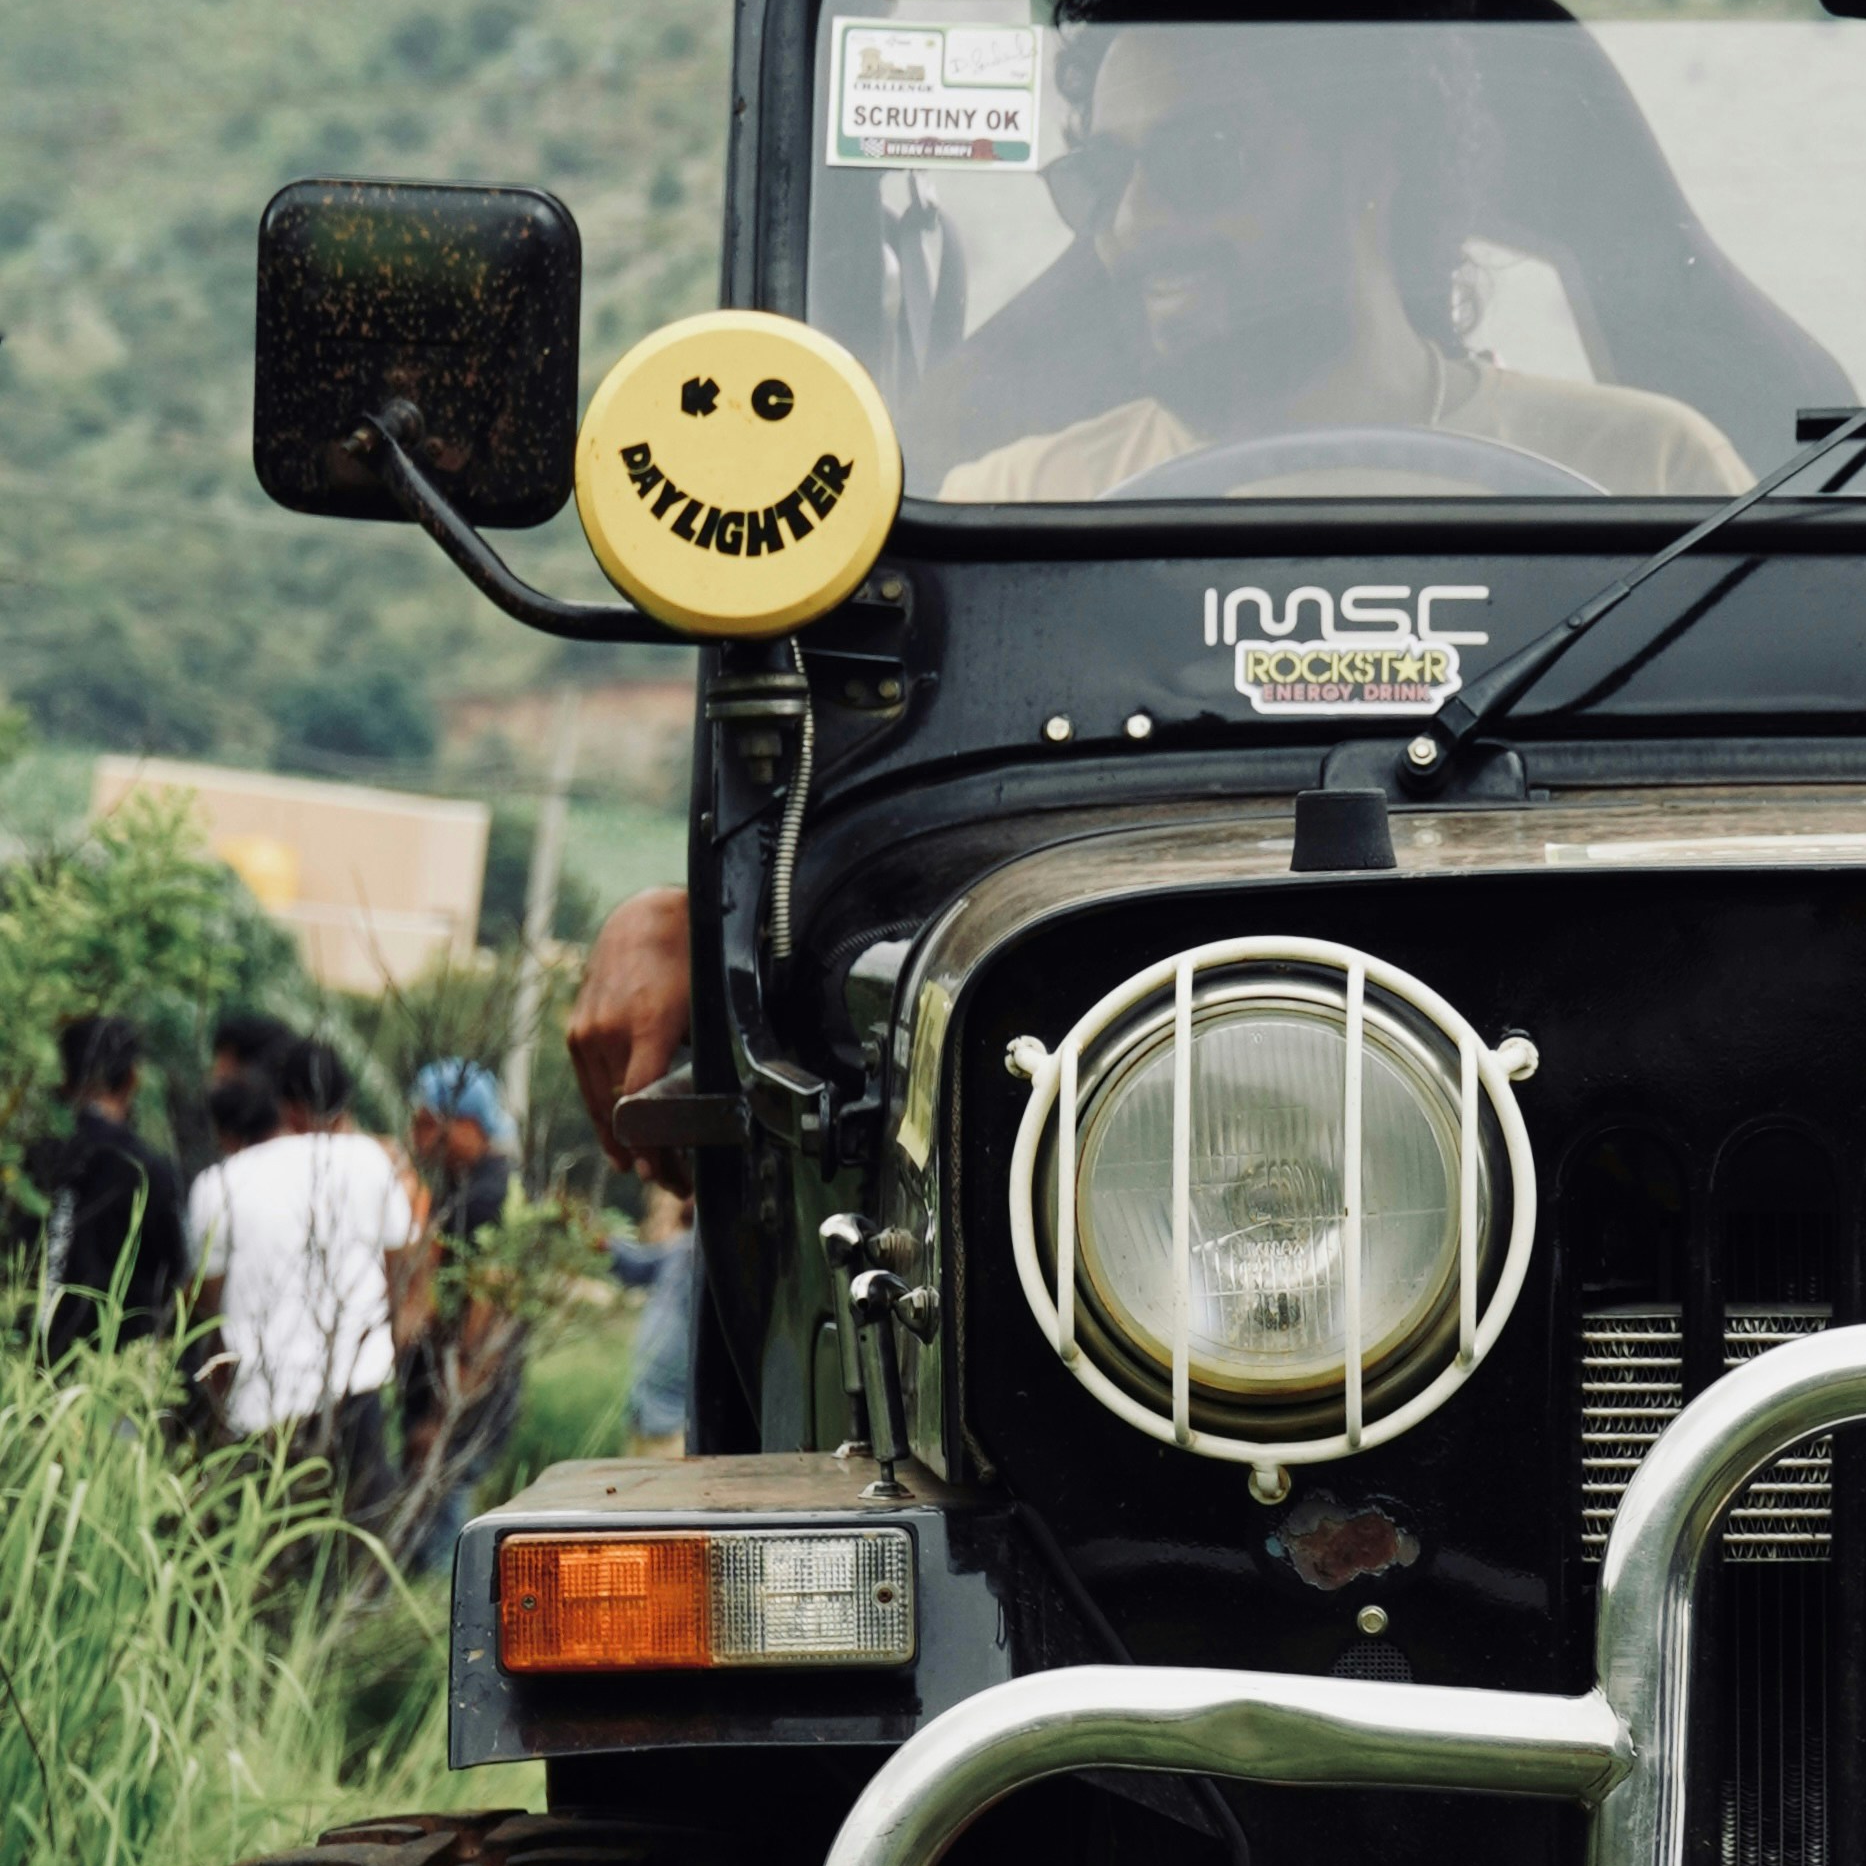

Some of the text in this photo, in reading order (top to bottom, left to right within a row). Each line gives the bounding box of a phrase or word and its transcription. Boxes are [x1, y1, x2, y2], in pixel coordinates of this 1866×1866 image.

[853, 105, 1021, 131] SCRUTINY OK
[618, 441, 855, 558] DAYLIGHTER
[1203, 584, 1490, 647] IMSC
[1262, 684, 1430, 702] ENERGY DRINK
